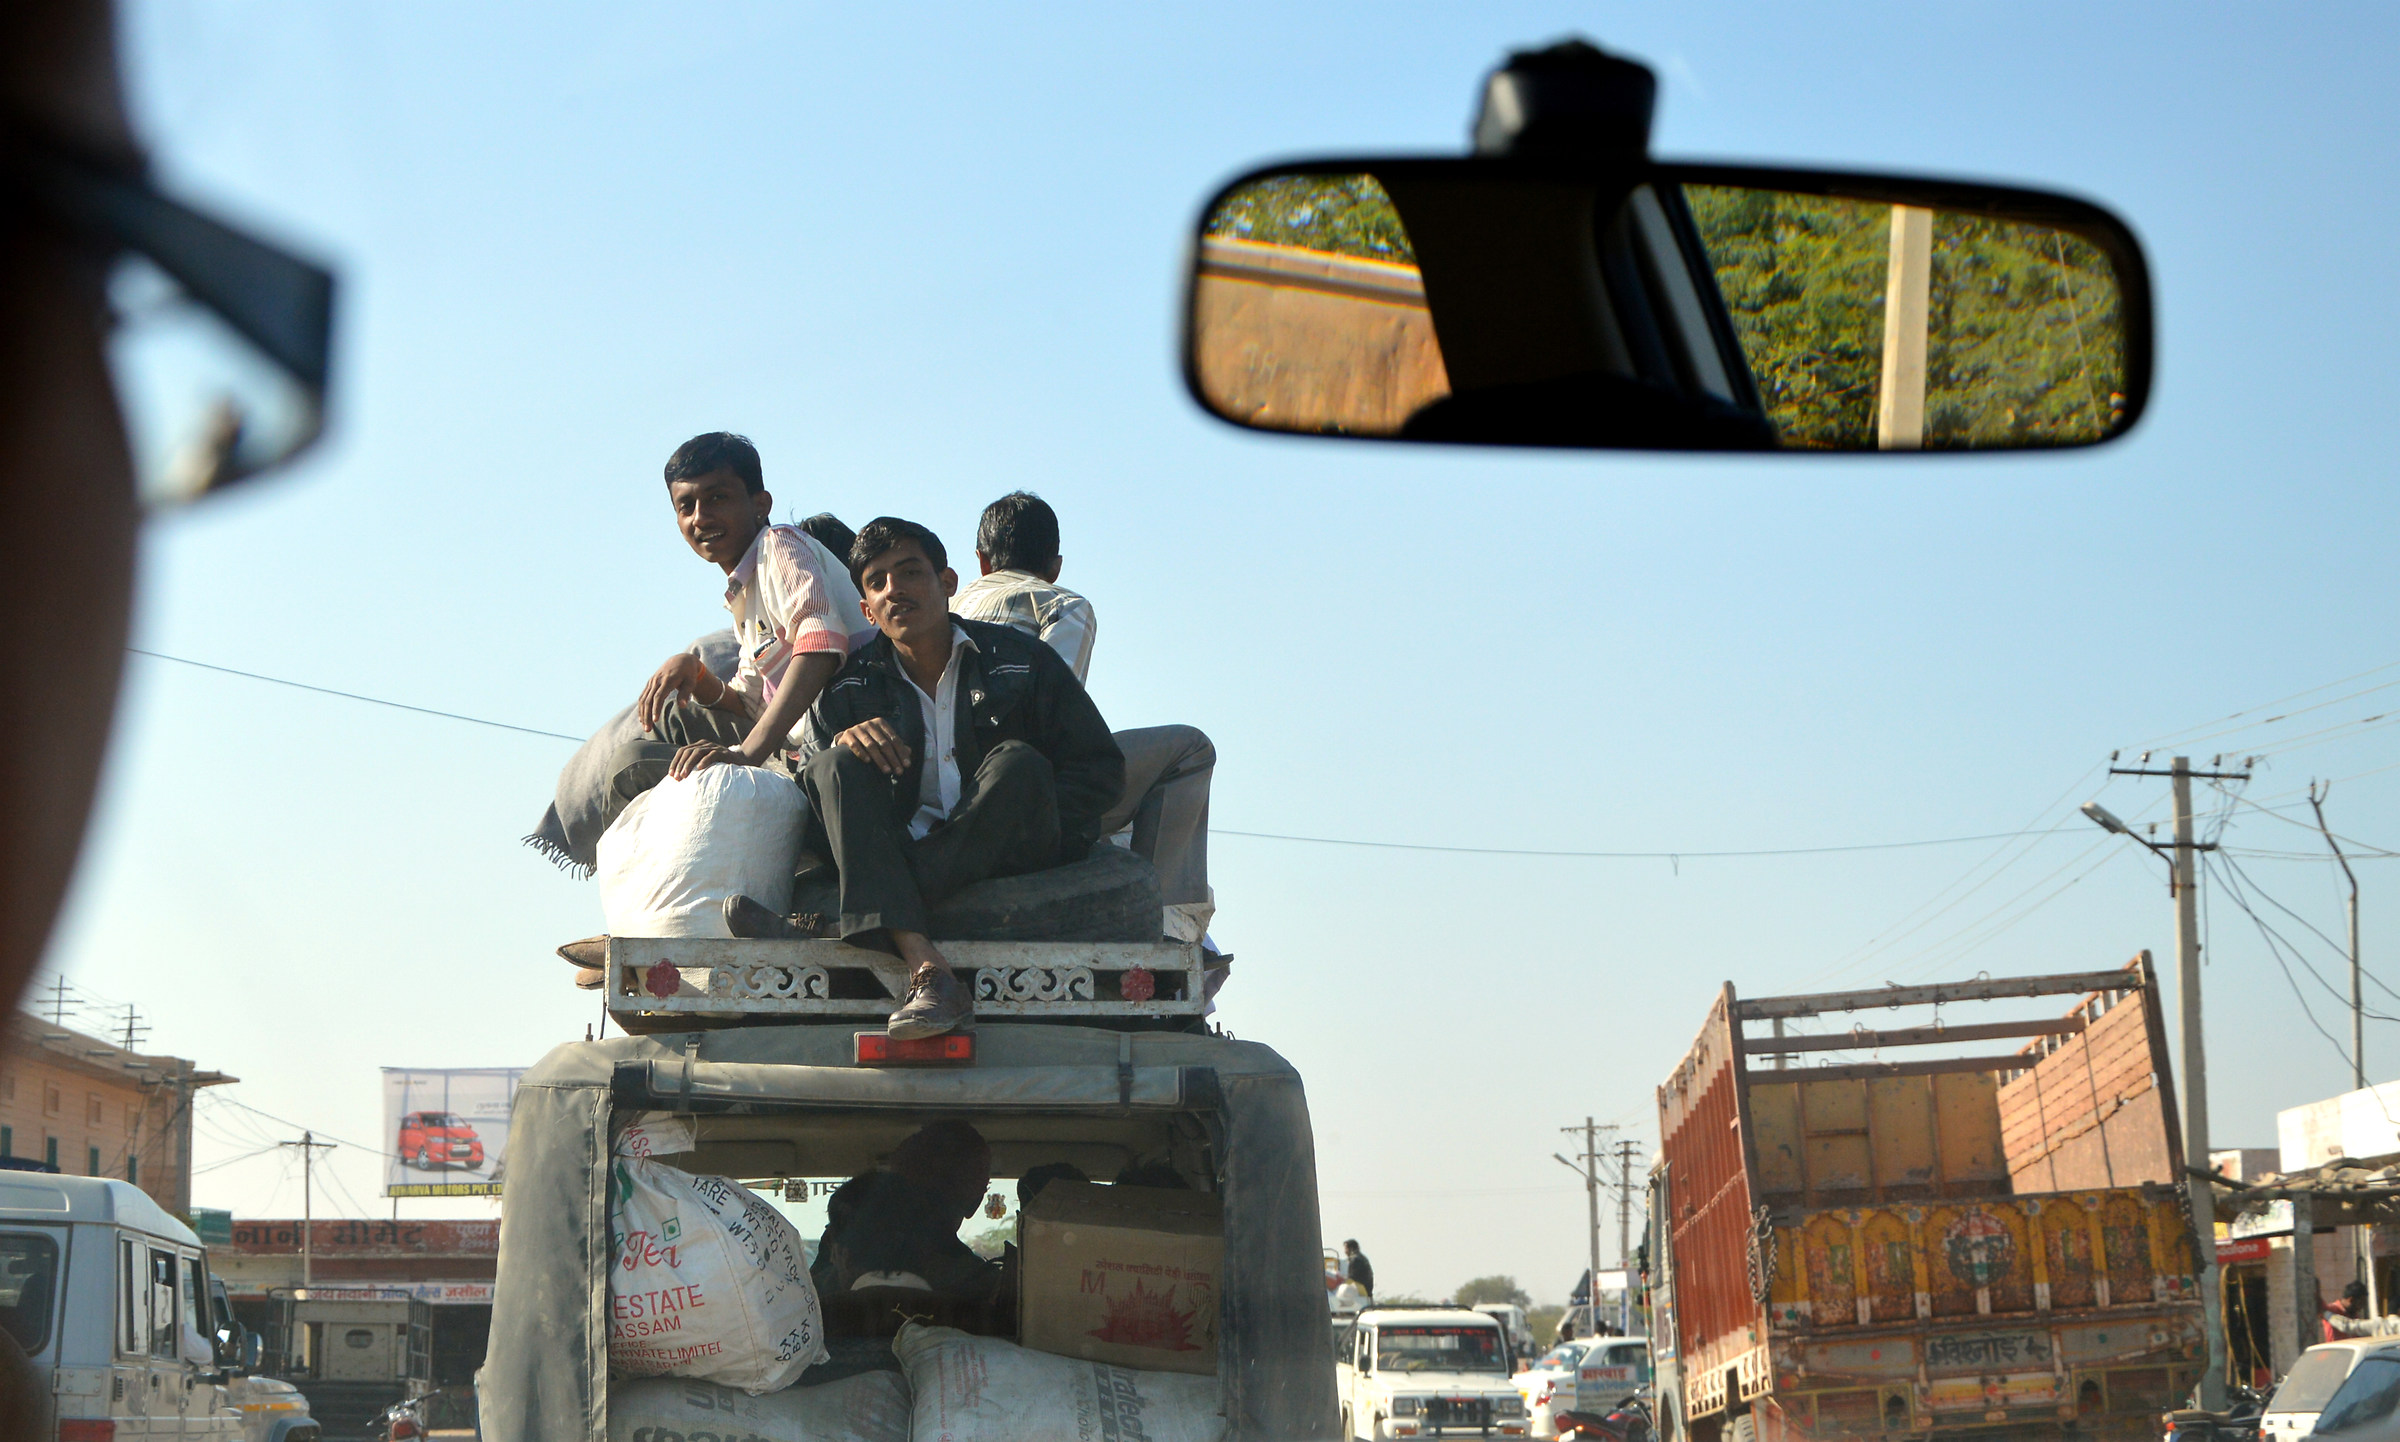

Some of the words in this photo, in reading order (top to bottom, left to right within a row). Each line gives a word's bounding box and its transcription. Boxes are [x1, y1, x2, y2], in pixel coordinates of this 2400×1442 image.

[390, 1185, 430, 1196] ATHARVA
[432, 1184, 470, 1195] MOTORS
[492, 1183, 502, 1194] LT
[614, 1284, 705, 1319] ESTATE
[614, 1315, 682, 1339] ASSAM
[609, 1348, 666, 1360] PRIVATE
